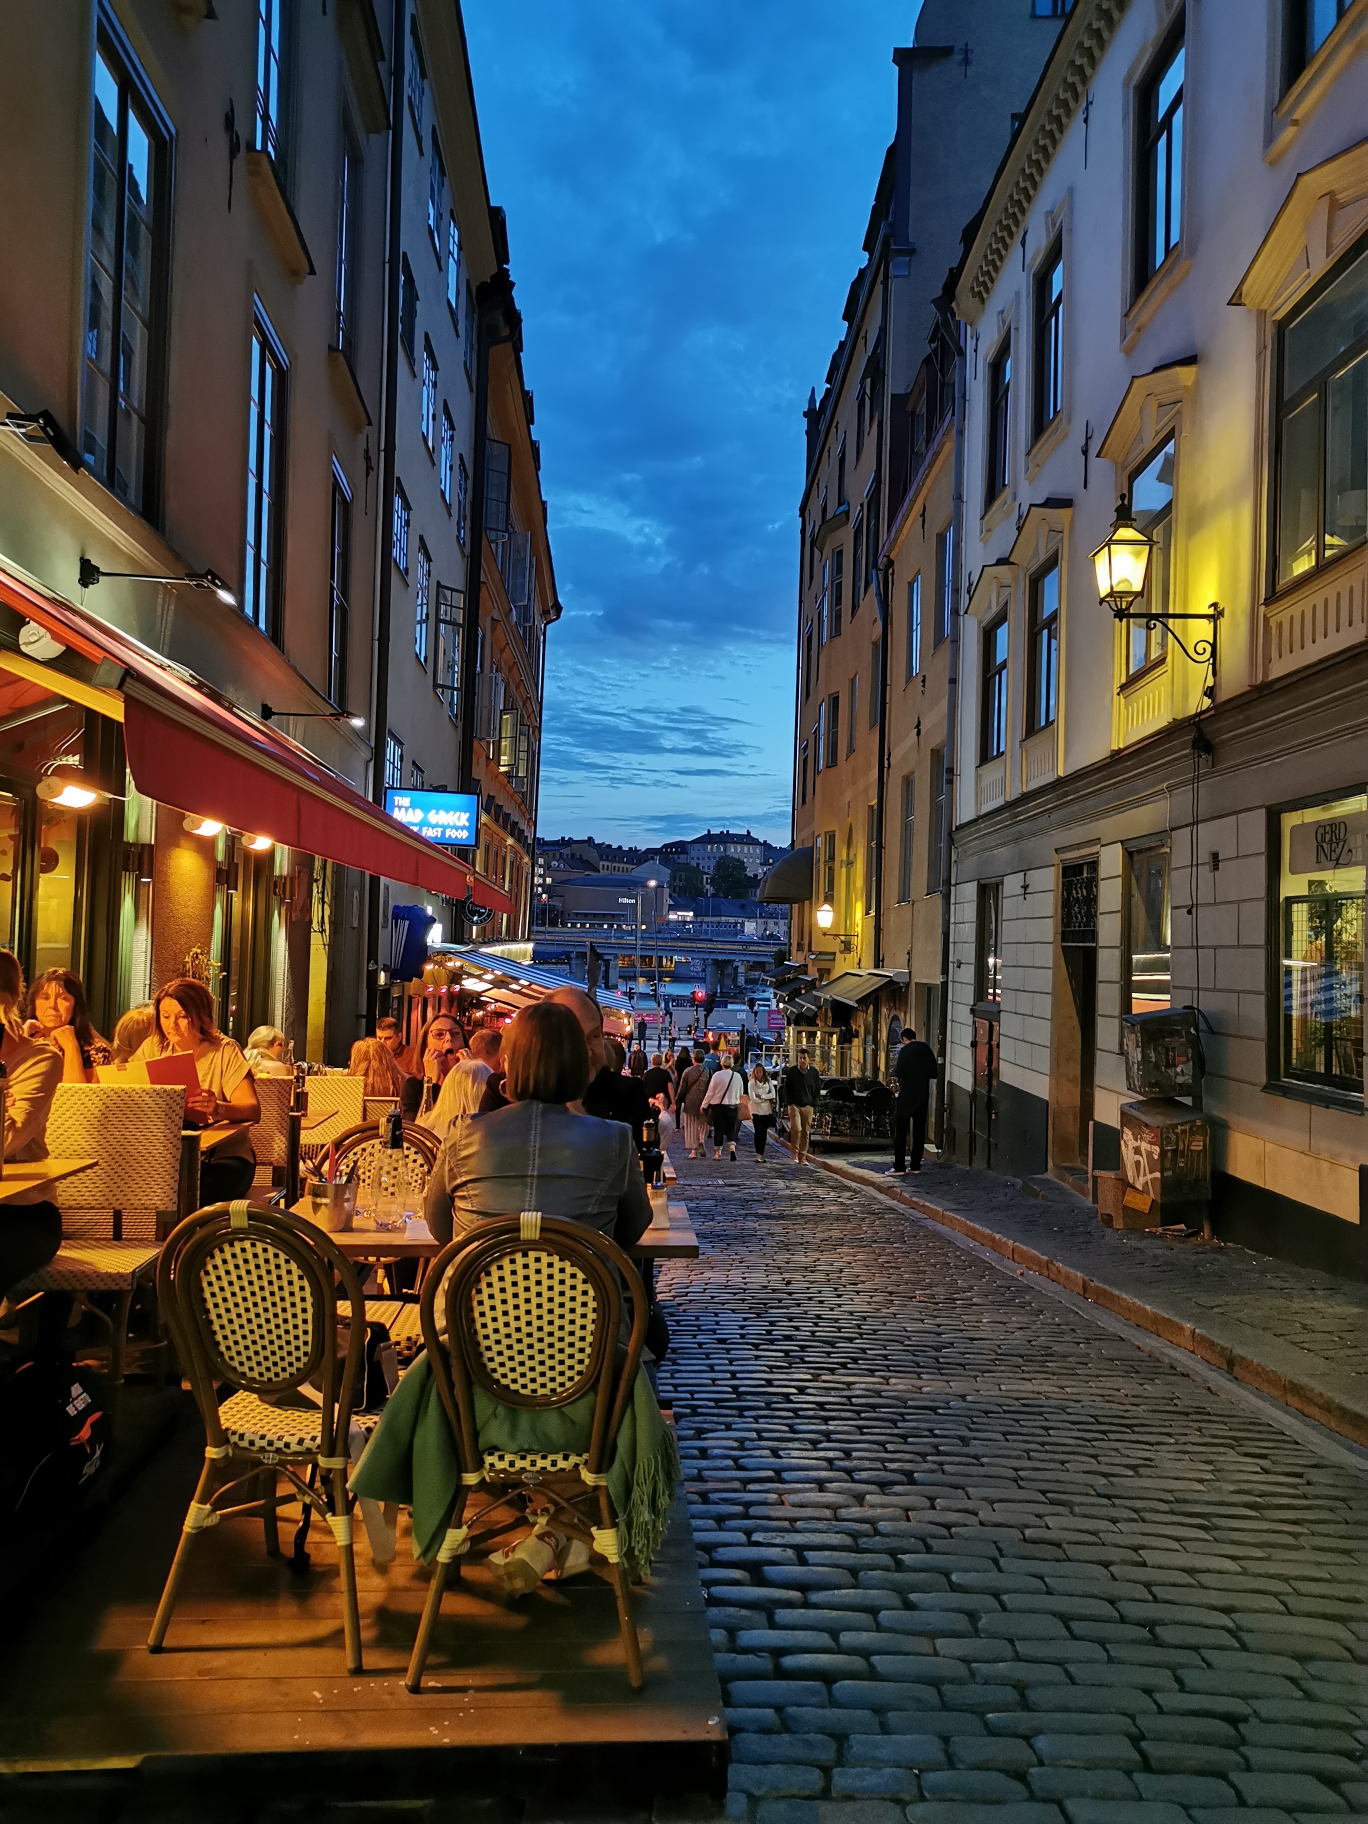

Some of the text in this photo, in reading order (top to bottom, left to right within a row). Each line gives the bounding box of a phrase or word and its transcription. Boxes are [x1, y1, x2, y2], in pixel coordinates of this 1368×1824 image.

[394, 796, 411, 806] THE
[393, 807, 424, 823] MAD
[422, 827, 443, 838] FAST
[446, 828, 469, 839] FOOD
[1315, 821, 1347, 844] GERD
[1315, 838, 1353, 868] INEZ
